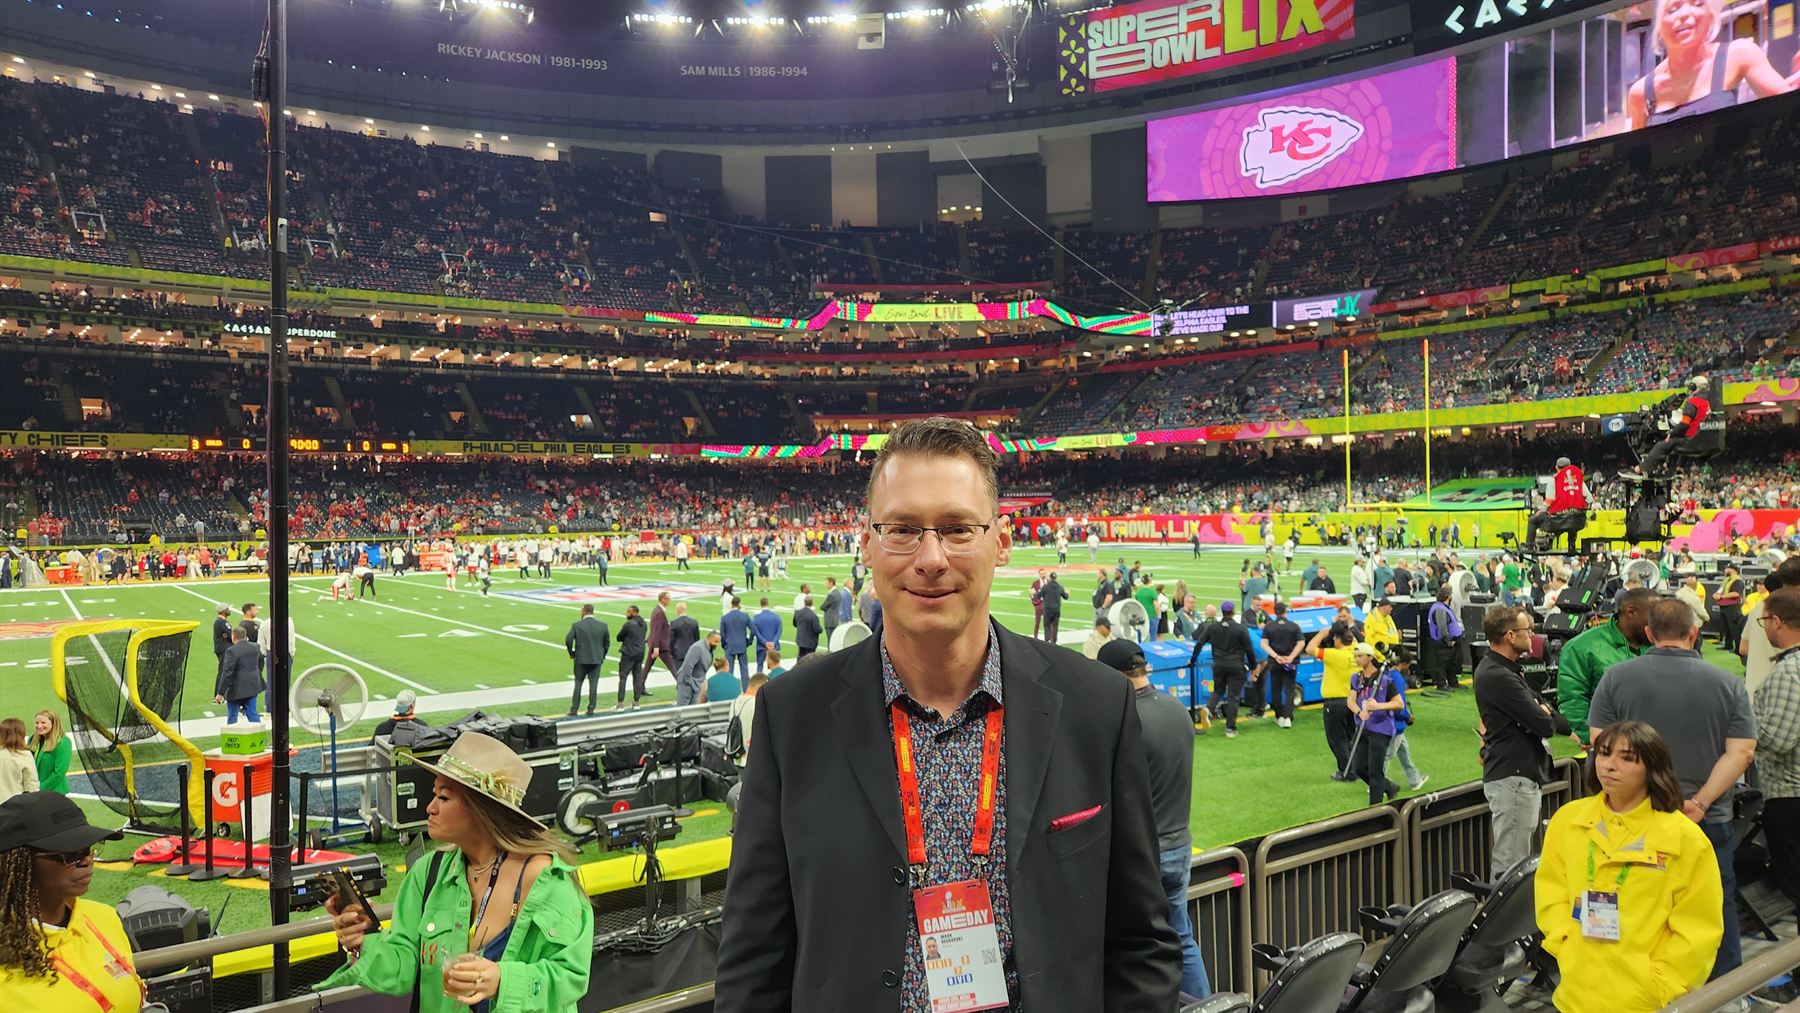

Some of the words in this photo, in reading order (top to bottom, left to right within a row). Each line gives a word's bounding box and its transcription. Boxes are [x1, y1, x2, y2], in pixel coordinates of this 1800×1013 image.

[1087, 1, 1221, 50] SUPER
[1223, 0, 1325, 55] LIX
[438, 43, 482, 58] RICKEY
[485, 49, 541, 65] JACKSON
[550, 56, 608, 70] 1981-1993
[1088, 29, 1221, 80] BOWL
[680, 65, 706, 76] SAM
[708, 66, 741, 77] MILLS
[749, 66, 808, 77] 1986-1994
[934, 306, 963, 319] LIVE
[1225, 307, 1235, 316] TO
[1235, 305, 1250, 315] THE
[224, 323, 271, 335] CAESAR
[27, 433, 109, 447] CHIEFS
[462, 441, 567, 454] PHILADELPHIA
[573, 442, 631, 455] EAGLES
[211, 772, 238, 807] G
[923, 908, 989, 934] GAMEDAY
